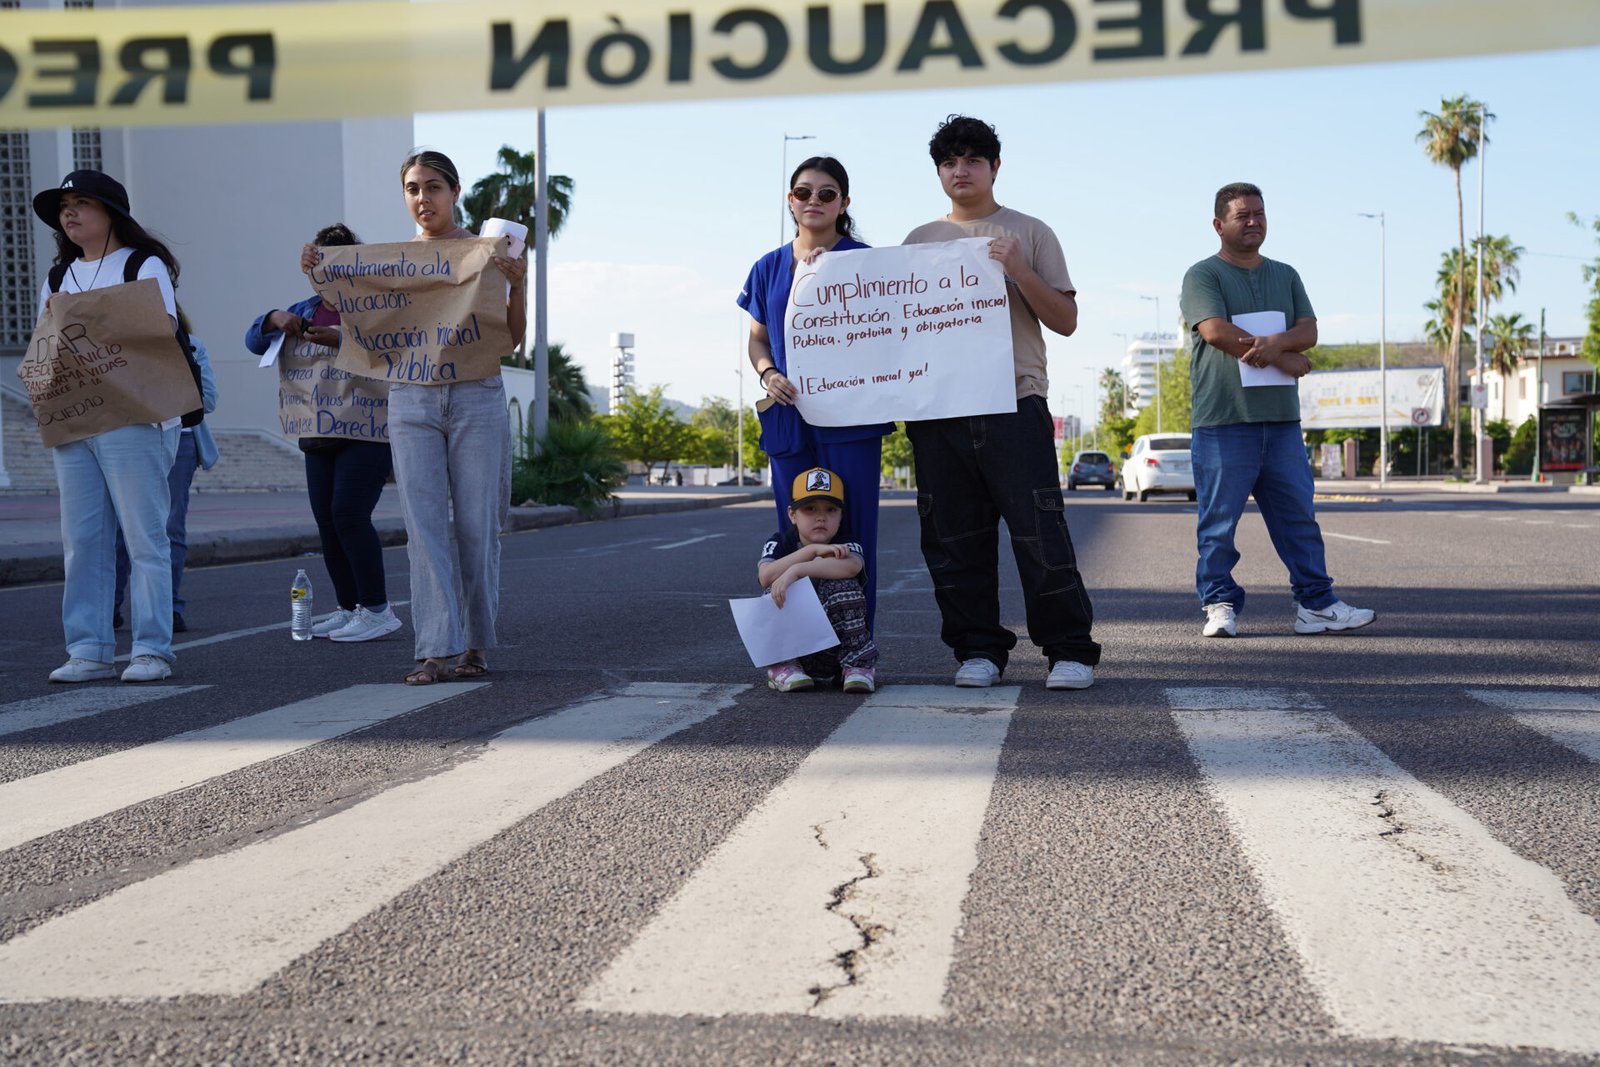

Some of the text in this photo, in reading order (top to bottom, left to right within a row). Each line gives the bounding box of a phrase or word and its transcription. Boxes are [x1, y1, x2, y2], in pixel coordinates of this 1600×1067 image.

[311, 251, 416, 287] Cumplimiento
[792, 264, 979, 311] Cumplimiento a la
[902, 297, 964, 319] Educación
[971, 294, 1007, 310] inicial
[348, 324, 429, 352] ducación
[846, 326, 893, 348] gratuita
[901, 326, 908, 341] y
[915, 313, 983, 335] obligatoria
[51, 360, 70, 375] EL
[73, 343, 122, 366] INICIO
[86, 356, 128, 377] VIDAS
[78, 380, 88, 389] A
[871, 368, 902, 384] inicial
